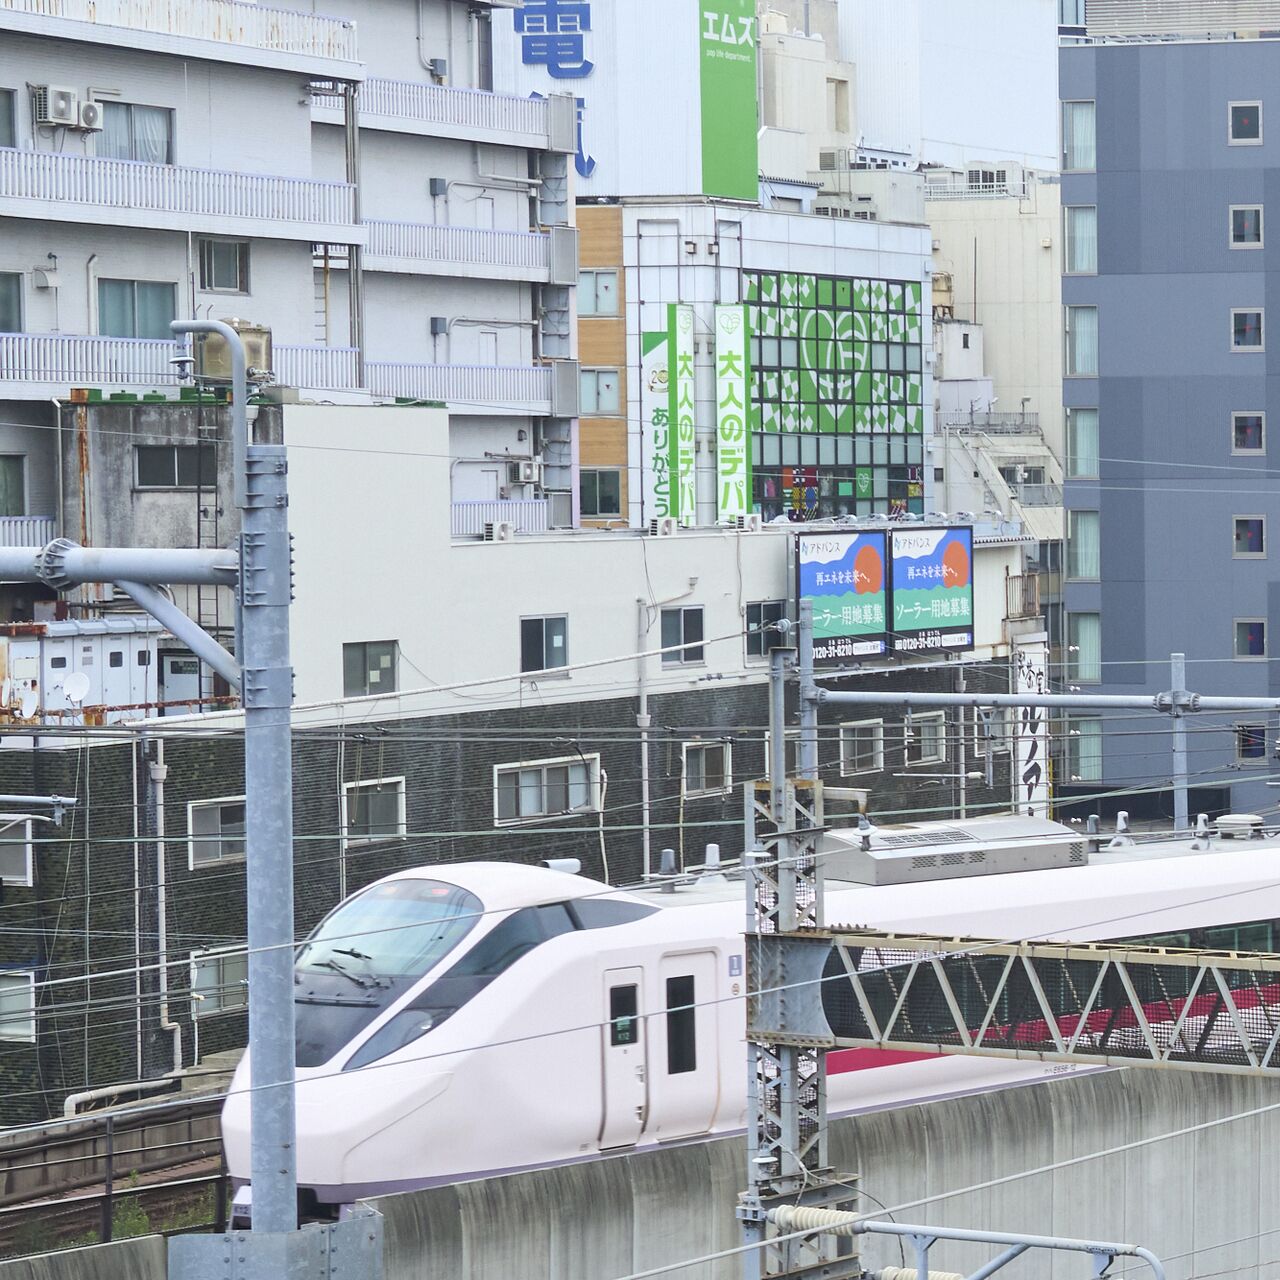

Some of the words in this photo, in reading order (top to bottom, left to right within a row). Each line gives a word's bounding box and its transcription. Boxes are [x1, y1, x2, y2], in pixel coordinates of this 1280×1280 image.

[703, 11, 754, 48] エムズ
[651, 408, 670, 518] ありがとう
[809, 541, 841, 554] アドバンス
[901, 537, 931, 550] アドバンス
[816, 569, 871, 586] 再エネを未来へ。
[907, 564, 958, 580] 再エネを未来へ。
[813, 603, 884, 628] ーラー用地募集
[896, 598, 970, 620] ソーラー用地募集
[902, 636, 941, 650] 0120-31-8210
[1020, 705, 1043, 817] ルノア
